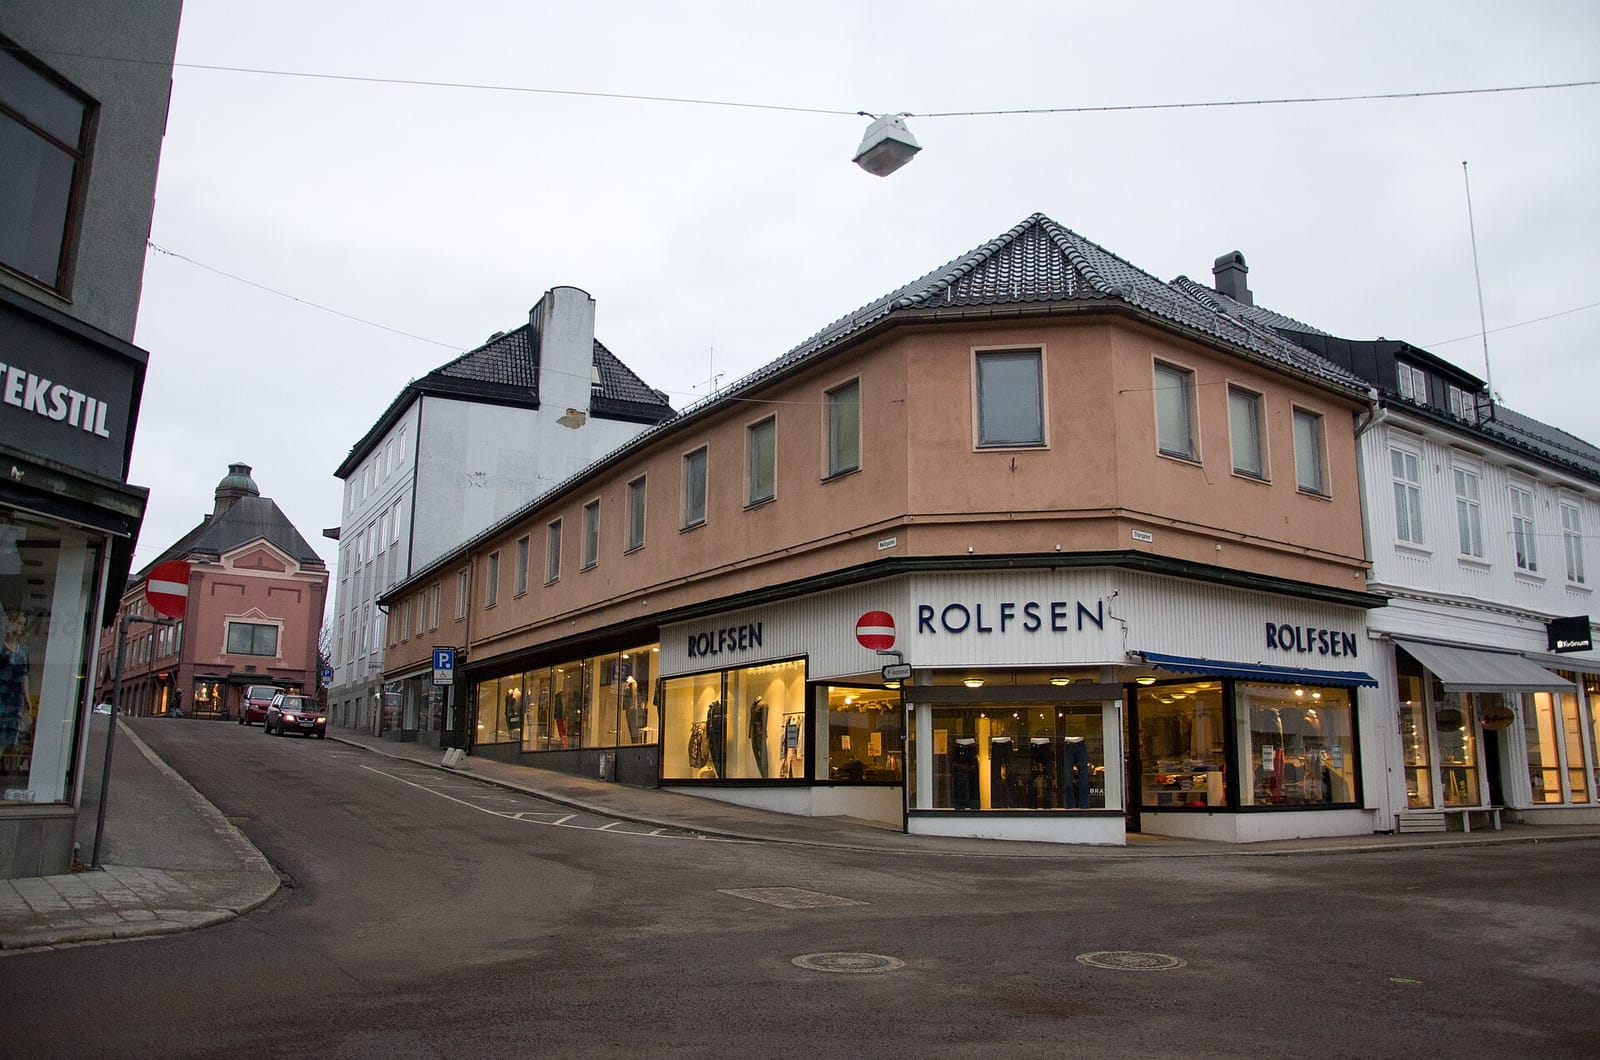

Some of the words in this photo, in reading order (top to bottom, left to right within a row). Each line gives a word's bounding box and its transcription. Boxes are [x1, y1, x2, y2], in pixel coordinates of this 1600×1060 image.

[918, 600, 1104, 634] ROLFSEN
[688, 622, 763, 658] ROLFSEN
[1266, 622, 1358, 658] ROLFSEN
[439, 653, 449, 668] P
